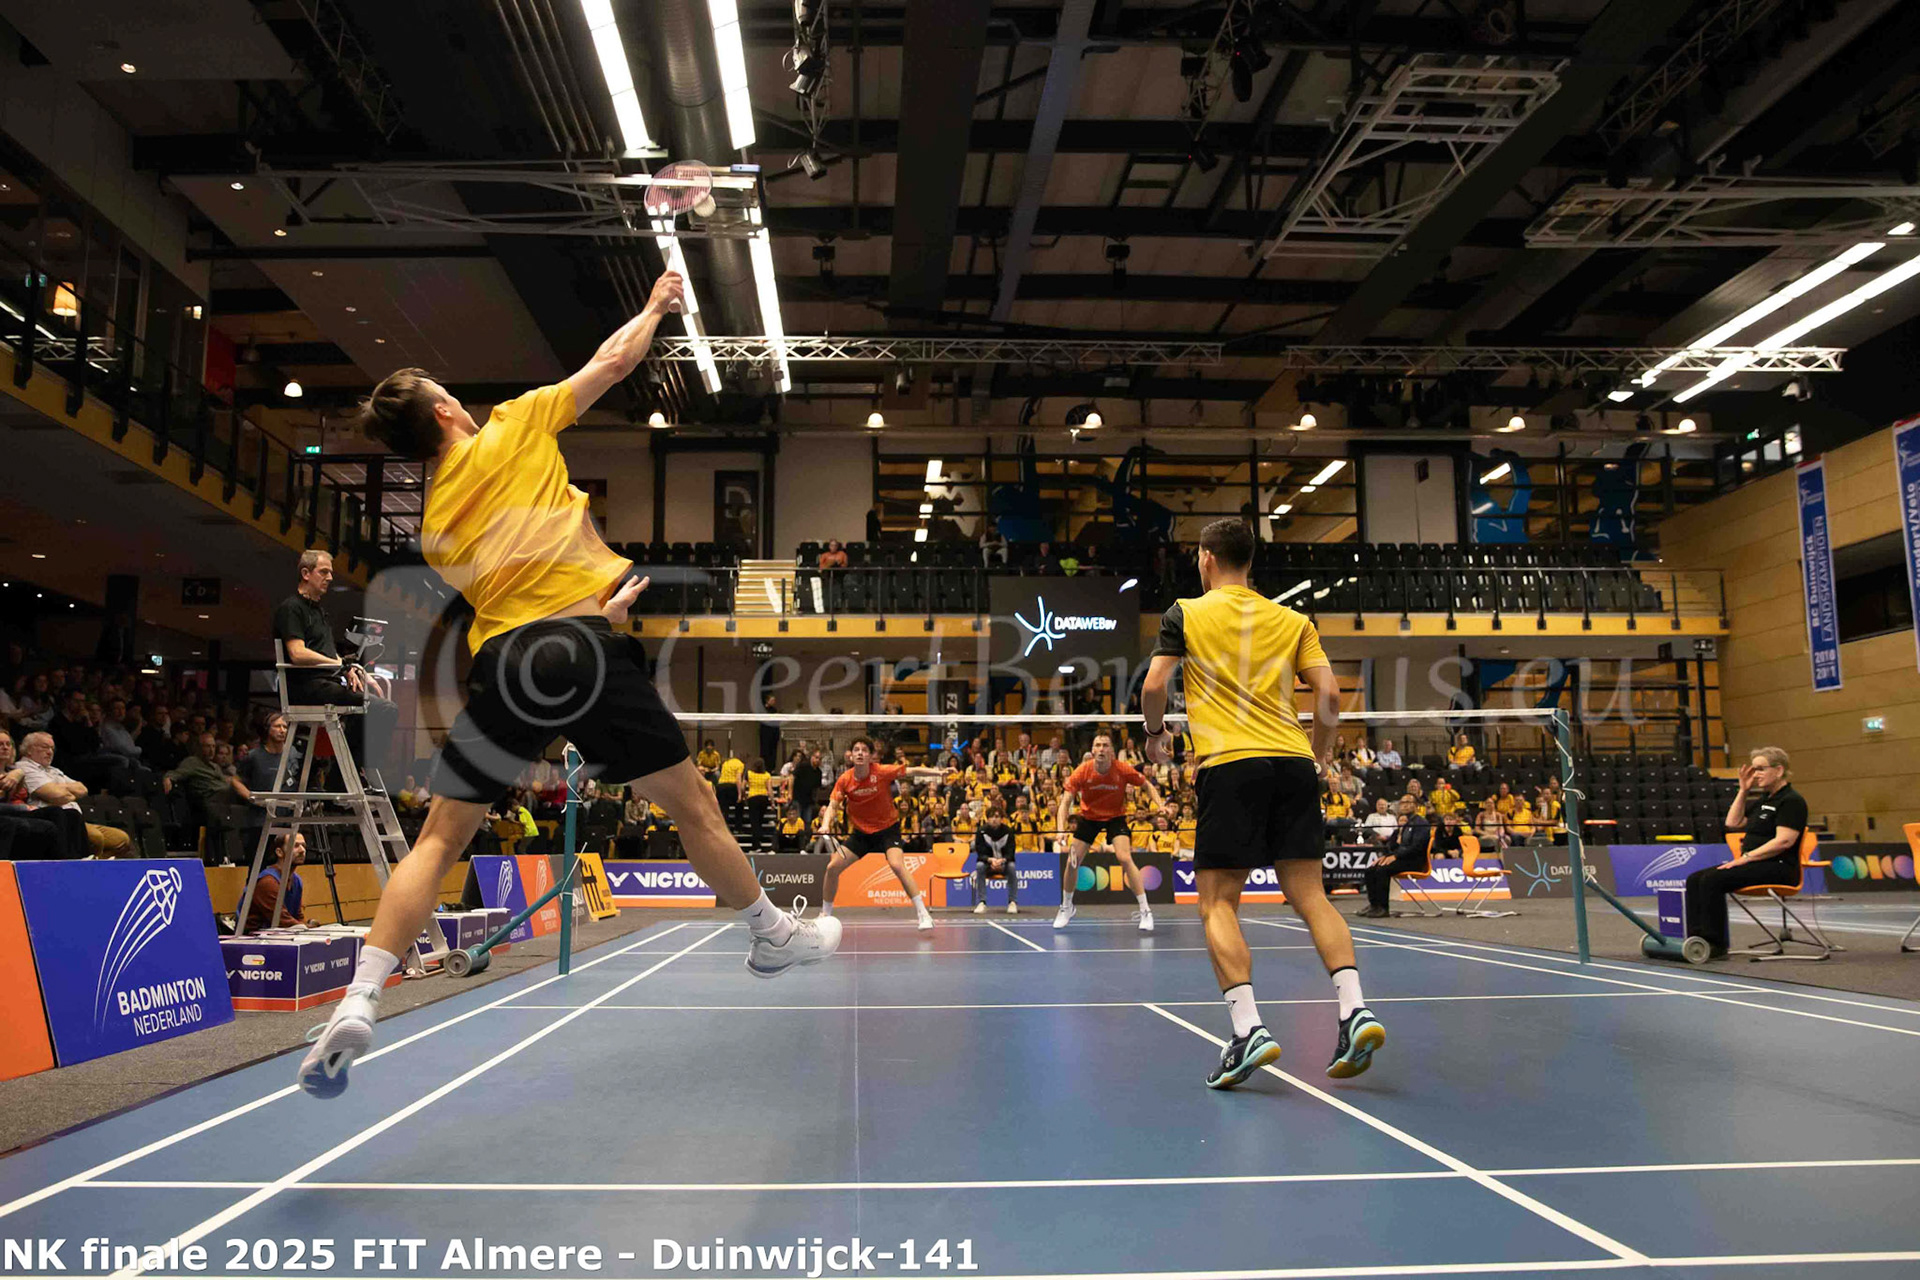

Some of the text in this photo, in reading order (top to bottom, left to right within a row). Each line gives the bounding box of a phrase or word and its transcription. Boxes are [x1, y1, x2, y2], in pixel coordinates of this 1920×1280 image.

[1322, 852, 1378, 869] ORZA
[1431, 867, 1504, 883] VICOR
[1550, 865, 1597, 876] DATEB
[766, 874, 814, 884] DATAWEB
[868, 890, 927, 898] BADMINN
[239, 970, 282, 981] VICTOR
[117, 976, 206, 1016] BADMINTON
[133, 1003, 202, 1037] NEDERLAND
